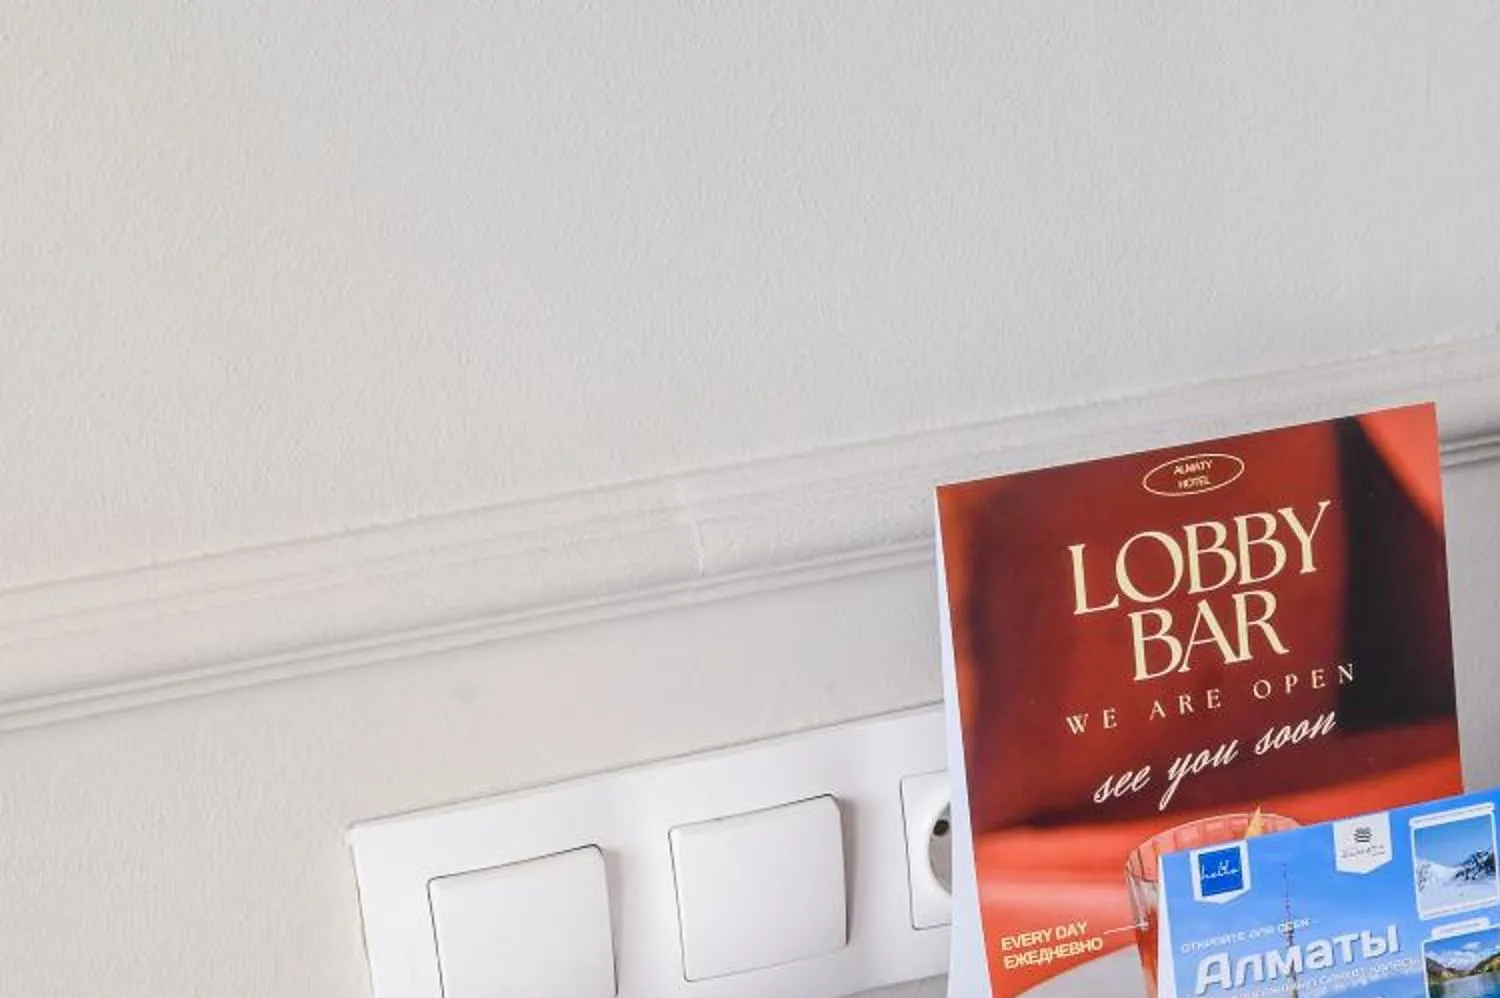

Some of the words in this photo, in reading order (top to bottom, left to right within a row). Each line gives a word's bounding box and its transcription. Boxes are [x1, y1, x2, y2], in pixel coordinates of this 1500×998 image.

[1067, 500, 1331, 616] LOBBY
[1128, 590, 1289, 682] BAR
[1066, 708, 1118, 735] WE
[1149, 688, 1221, 721] ARE
[1253, 662, 1357, 701] OPEN
[1093, 766, 1152, 804] see
[1162, 739, 1239, 809] you
[1255, 711, 1338, 756] soon
[1001, 928, 1053, 951] EVERY
[1055, 921, 1088, 940] DAY
[1003, 937, 1104, 970] ЕЖЕДНЕВНО
[1195, 924, 1401, 997] Алматы
